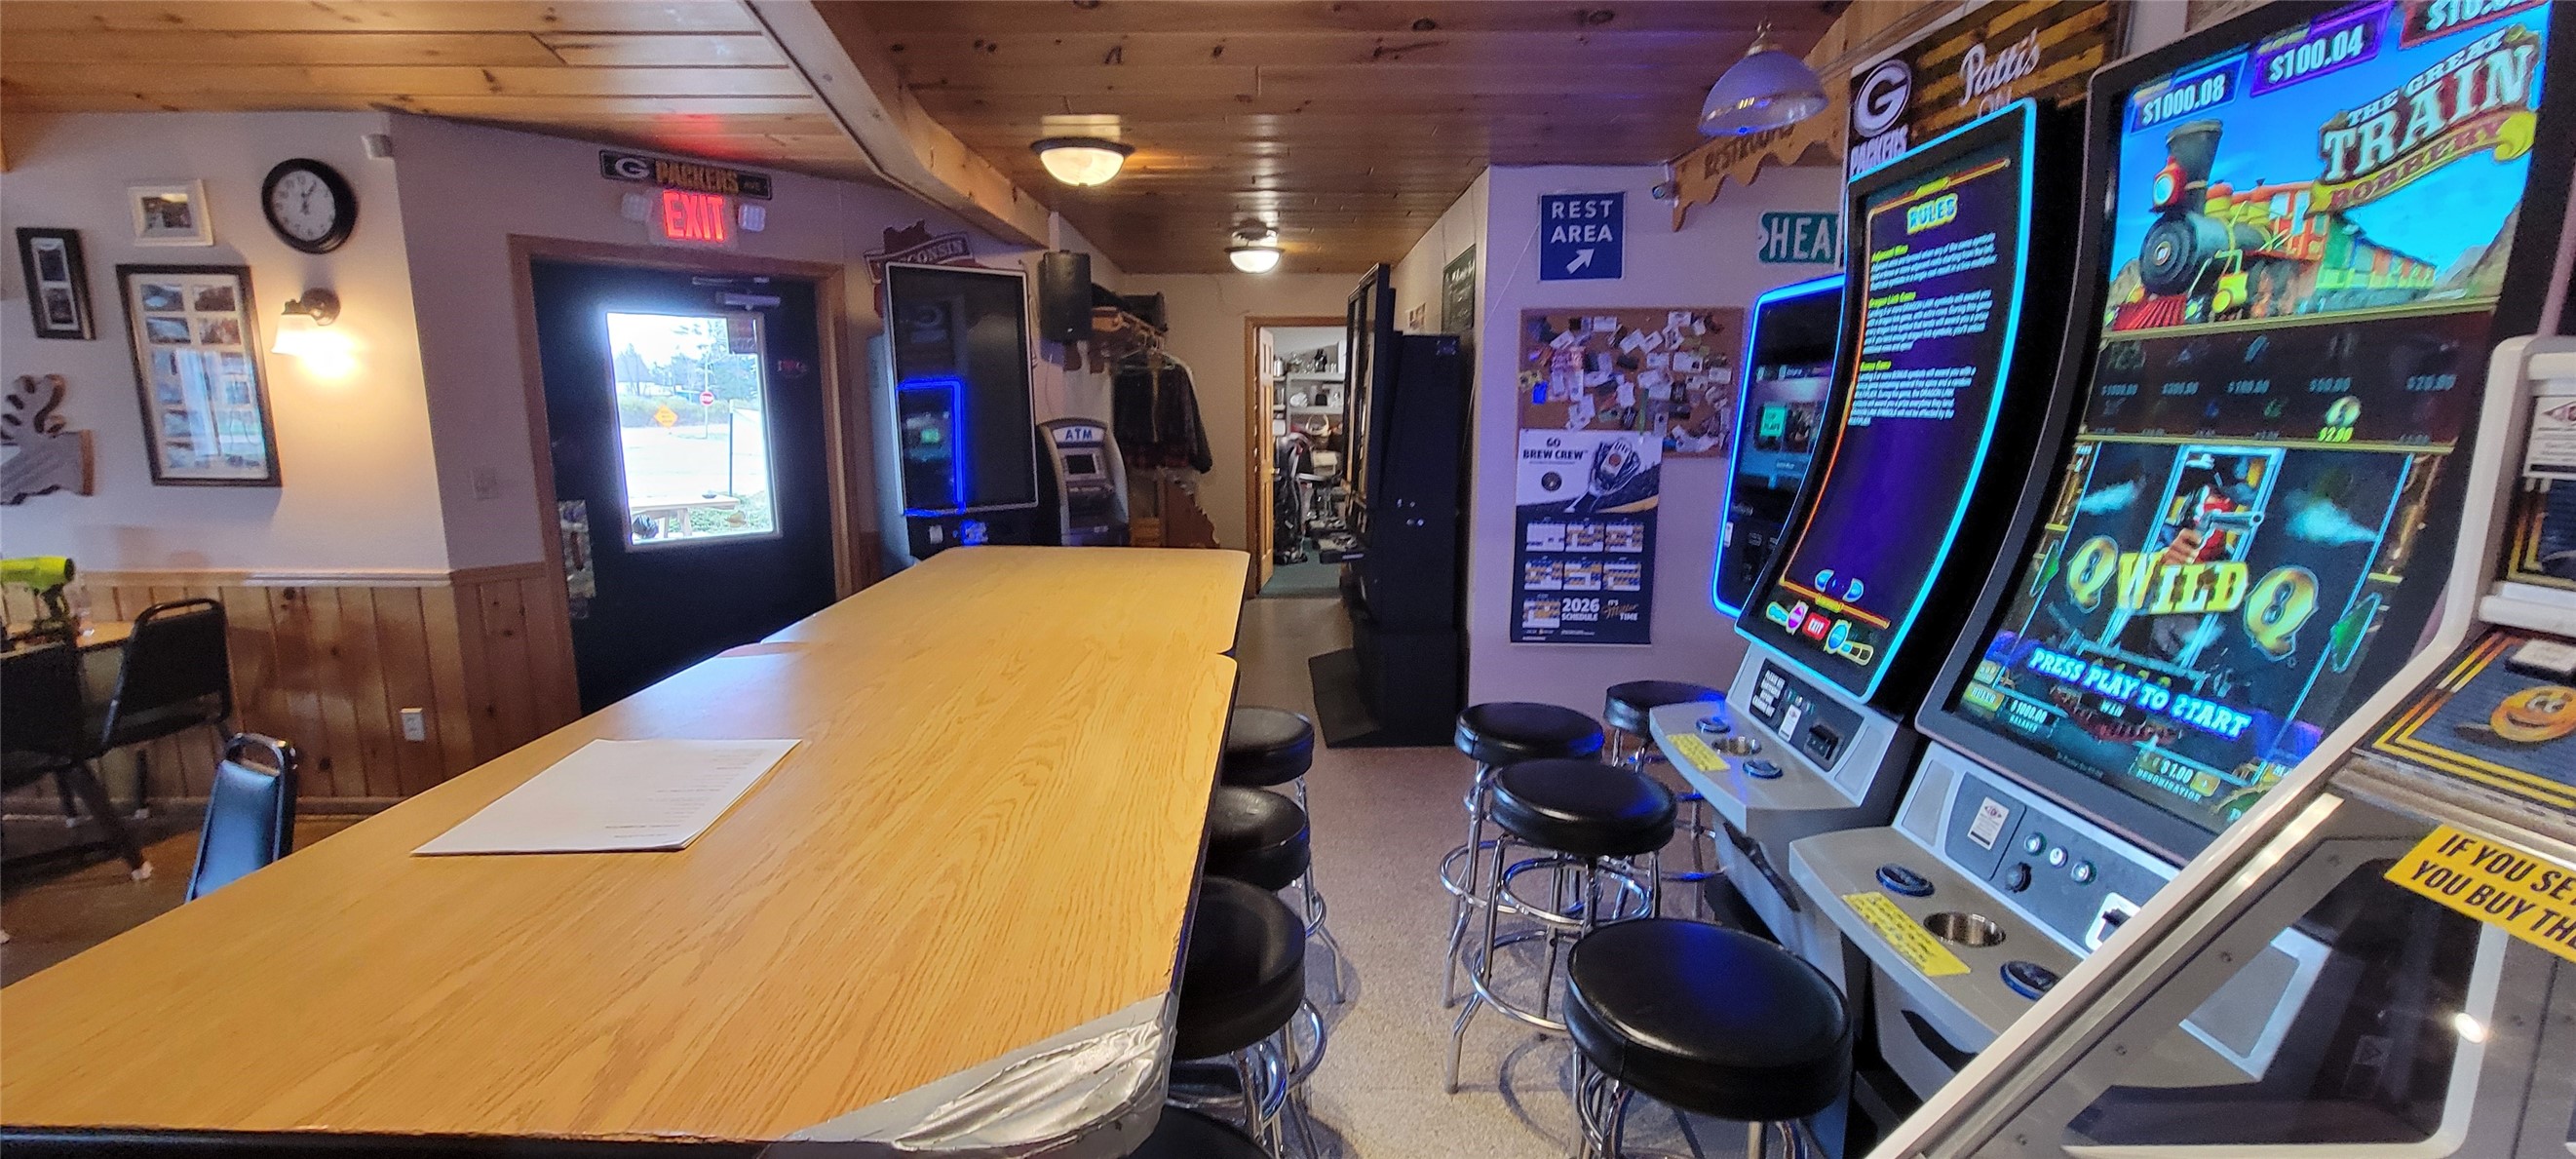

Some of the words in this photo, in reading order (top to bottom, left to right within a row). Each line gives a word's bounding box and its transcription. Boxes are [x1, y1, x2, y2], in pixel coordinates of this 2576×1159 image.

[2426, 0, 2526, 31] $10.
[1959, 27, 2041, 107] Patti's
[2268, 24, 2365, 84] $100.04
[2141, 73, 2226, 127] $1000.08
[2347, 90, 2400, 128] THE
[2403, 30, 2506, 97] GREAT
[2322, 45, 2535, 181] TRAIN
[1850, 124, 1908, 176] PACKERS
[2330, 121, 2504, 209] ROBBERY
[655, 160, 739, 193] PACKERS
[663, 190, 725, 242] EXIT
[1552, 200, 1613, 219] REST
[1907, 195, 1957, 232] RULES
[1551, 224, 1613, 244] AREA
[1769, 216, 1837, 260] HEA
[1065, 428, 1092, 441] ATM
[1522, 449, 1553, 460] BREW
[1547, 437, 1561, 447] GO
[1561, 613, 1598, 622] SCHEDULE
[1562, 598, 1600, 613] 2026
[2067, 535, 2120, 614] Q
[2118, 550, 2249, 615] WILD
[2244, 564, 2321, 662] Q
[2027, 647, 2087, 683] PRESS
[2083, 665, 2141, 702] PLAY
[2136, 683, 2172, 712] TO
[2171, 694, 2253, 739] START
[2099, 700, 2127, 718] WIN
[2410, 860, 2474, 896] YOU
[2465, 883, 2536, 922] BUY
[2437, 833, 2477, 858] IF
[2469, 844, 2537, 882] YOU
[2530, 870, 2576, 907] SE
